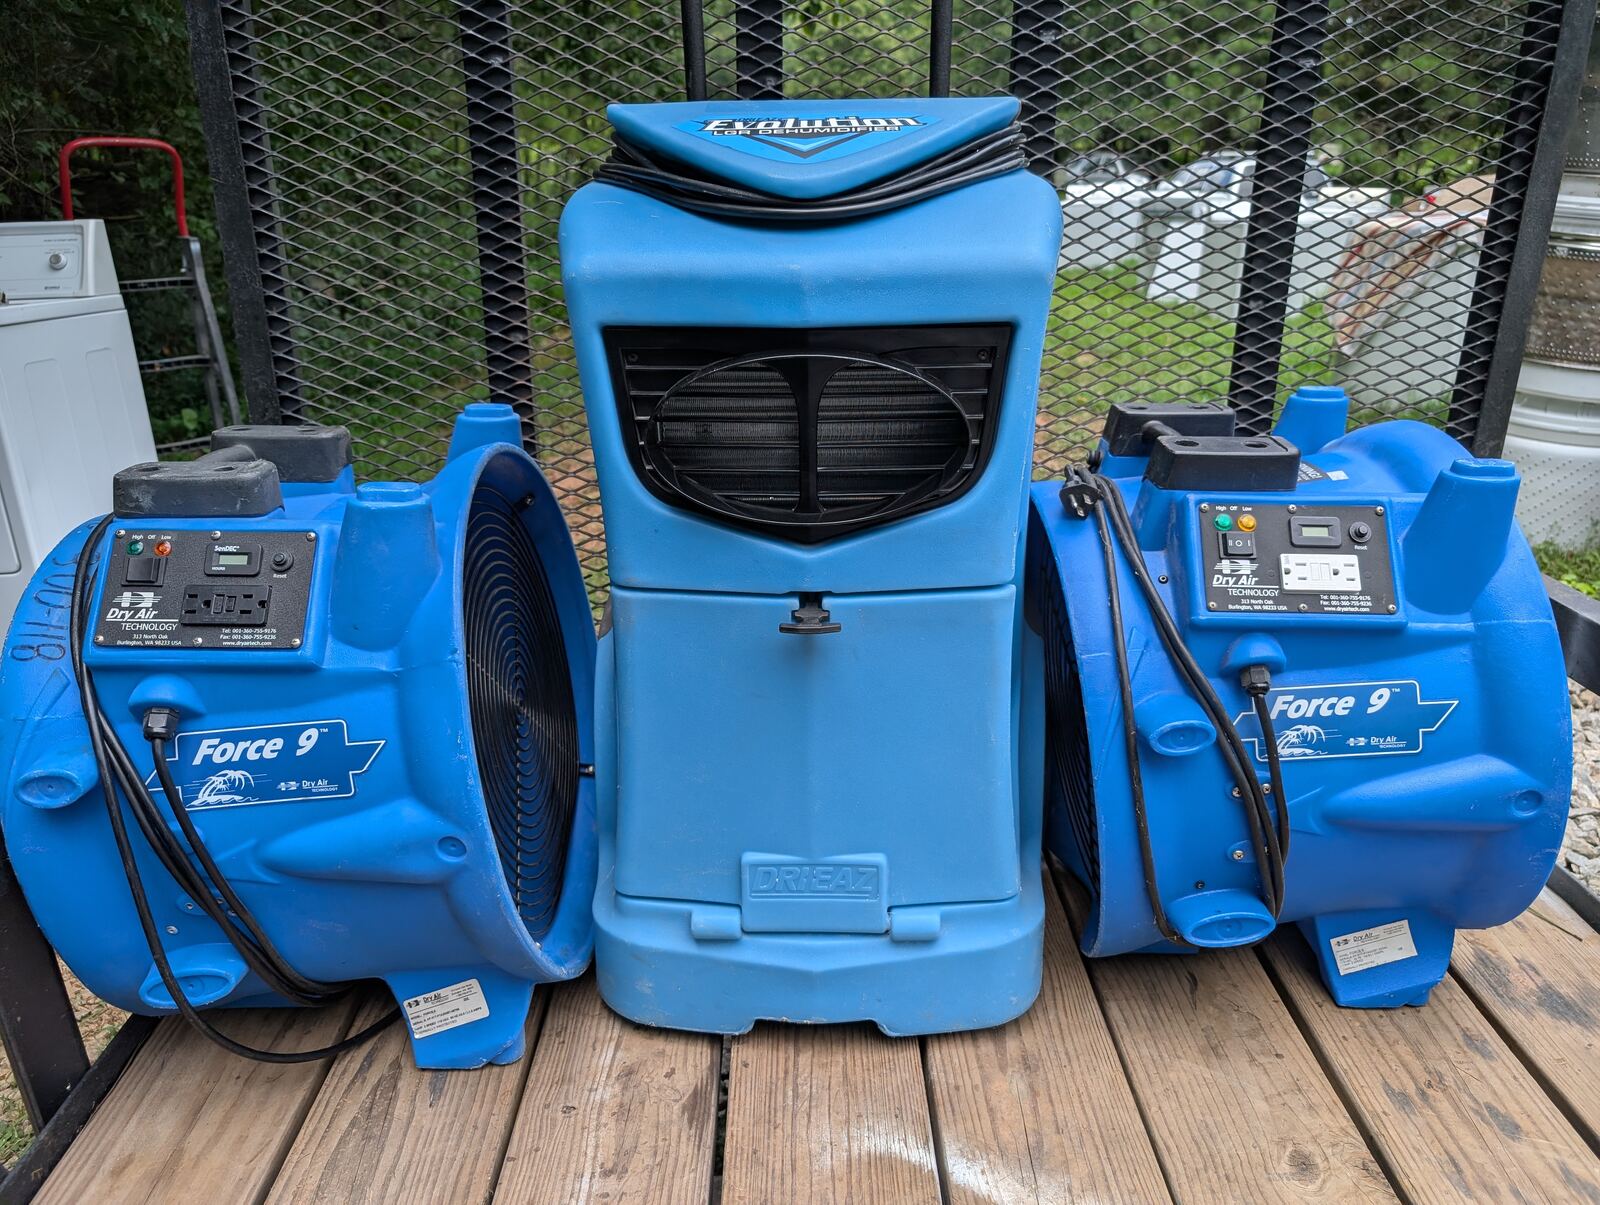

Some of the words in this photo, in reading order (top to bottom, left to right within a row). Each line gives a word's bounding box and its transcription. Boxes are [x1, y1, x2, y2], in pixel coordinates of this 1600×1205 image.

[703, 116, 925, 131] Evolution
[758, 126, 899, 135] DEHUMIDIFIER
[1212, 574, 1236, 587] Dry
[1238, 574, 1259, 585] Air
[1227, 588, 1279, 597] TECHNOLOGY
[106, 608, 135, 621] Dry
[135, 608, 159, 619] Air
[121, 623, 178, 631] TECHNOLOGY
[1270, 695, 1355, 720] Force
[192, 737, 284, 765] Force
[302, 780, 315, 788] Dry
